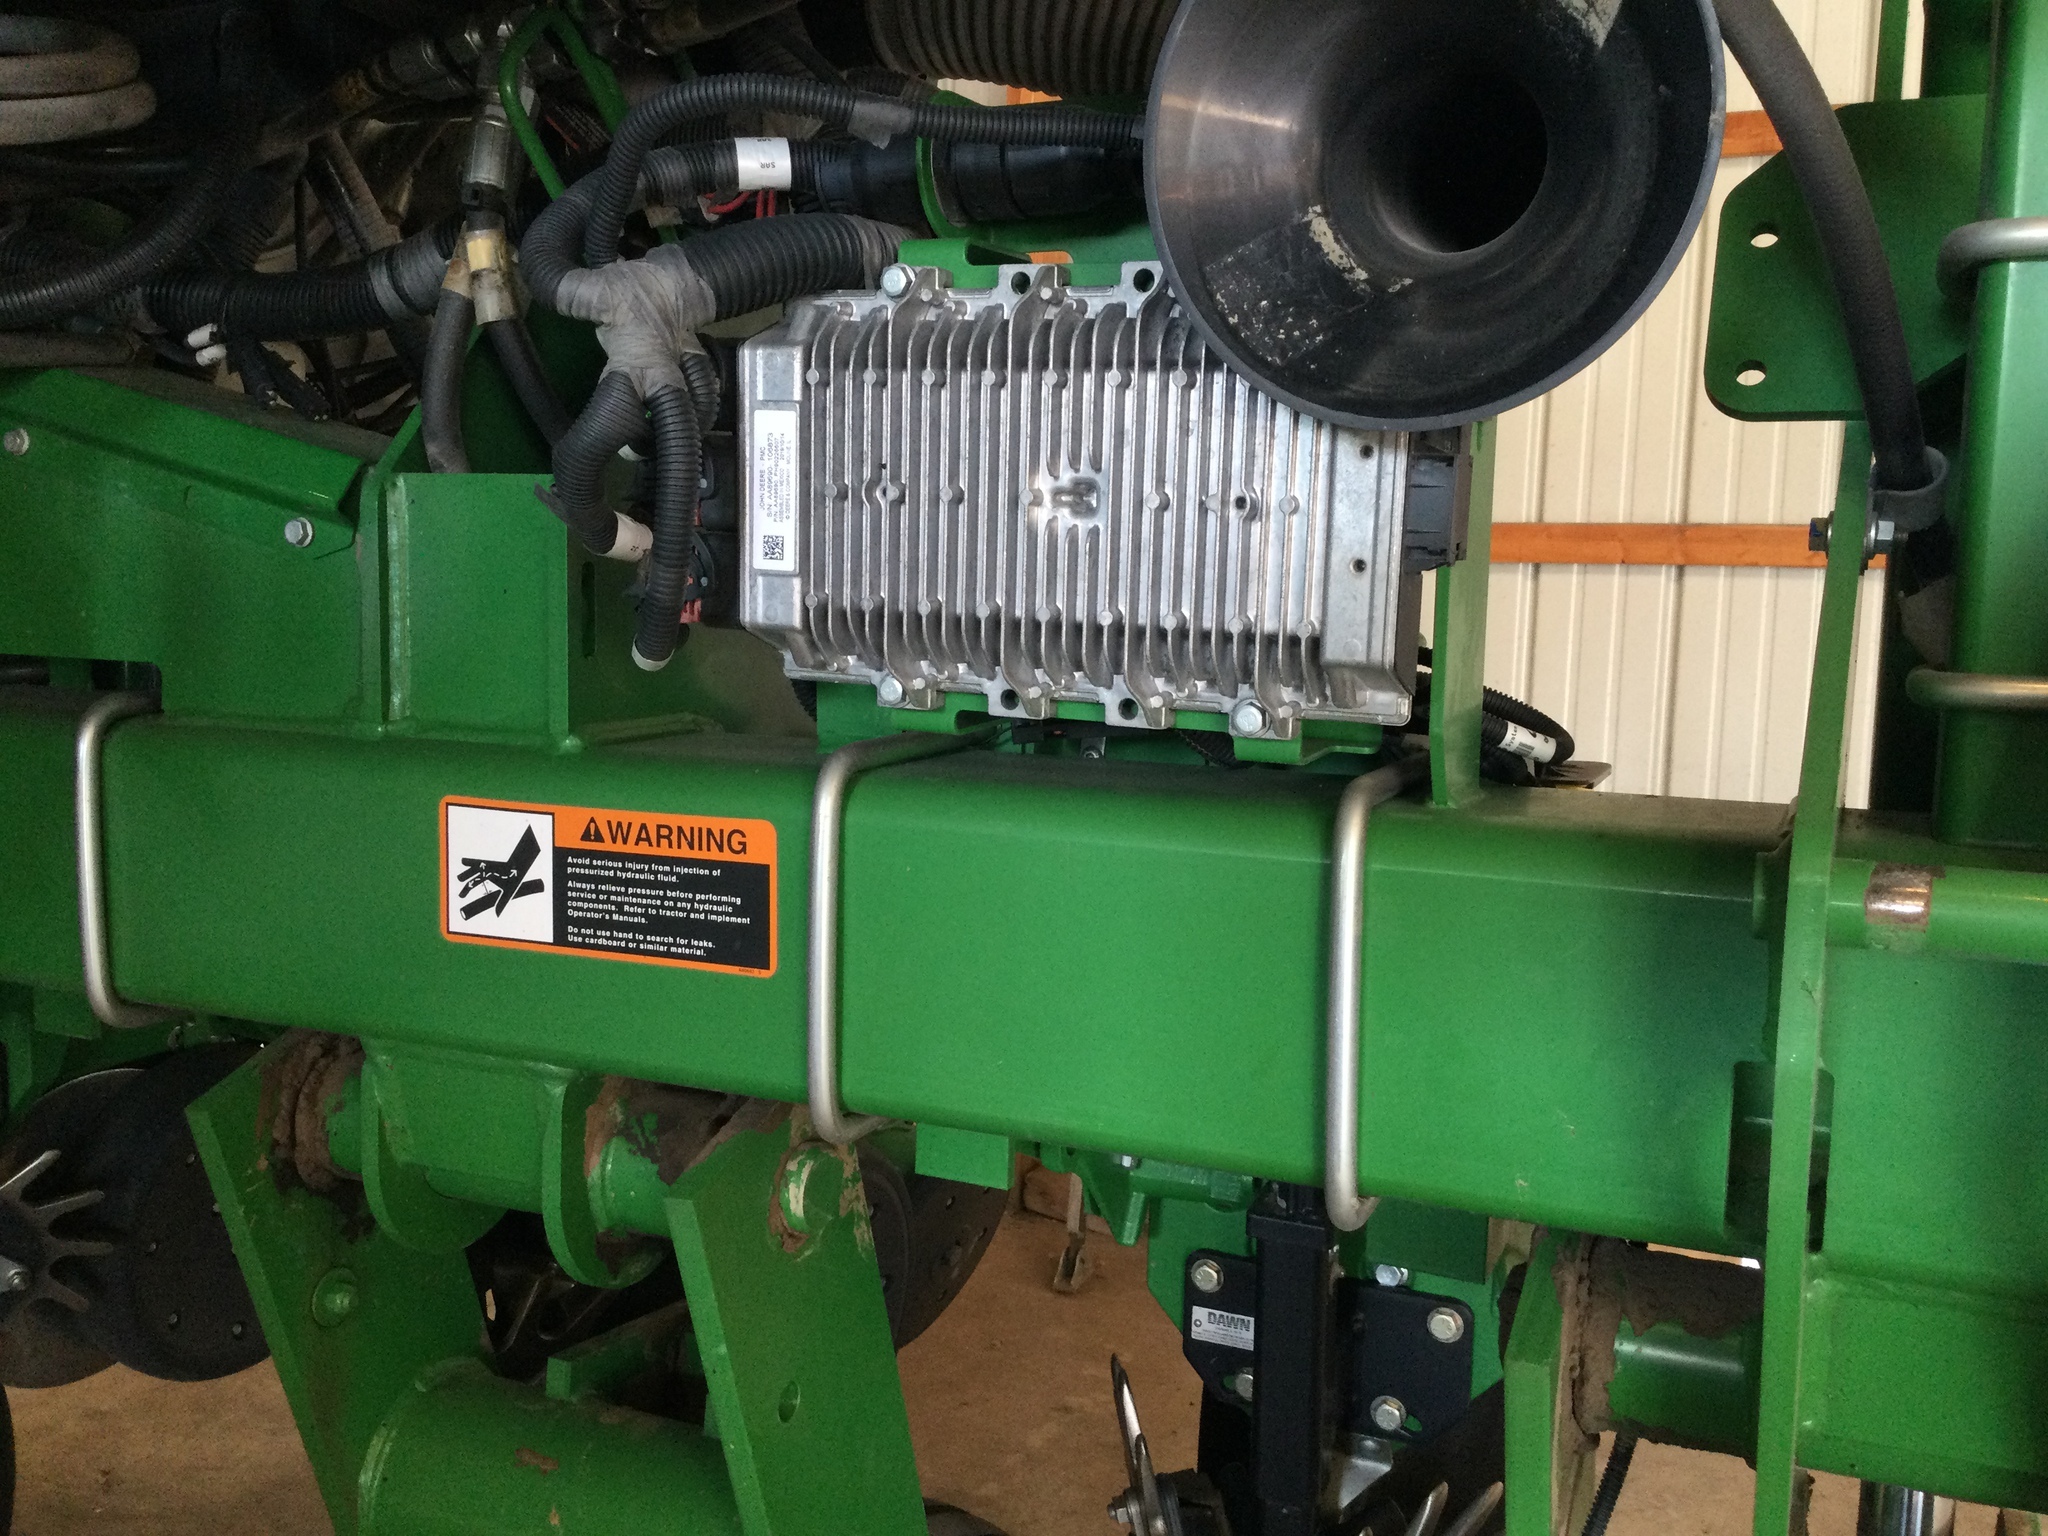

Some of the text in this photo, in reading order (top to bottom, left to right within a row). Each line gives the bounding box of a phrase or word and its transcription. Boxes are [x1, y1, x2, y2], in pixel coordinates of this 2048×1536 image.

[606, 820, 747, 855] WARNING
[567, 856, 590, 865] Avoid
[592, 859, 622, 868] serious
[625, 861, 649, 871] injury
[651, 863, 671, 872] from
[673, 865, 709, 875] injection
[567, 867, 680, 882] pressurized hydraulic fluid.
[567, 880, 741, 905] Always relieve pressure before performing
[567, 891, 597, 900] service
[610, 894, 662, 906] maintenance
[676, 901, 691, 910] any
[694, 902, 733, 913] hydraulic
[567, 900, 619, 911] components.
[624, 905, 646, 914] Refer
[659, 909, 687, 918] tractor
[690, 912, 705, 920] and
[707, 913, 751, 925] implement
[567, 909, 649, 924] Operator's Manuals.
[567, 925, 579, 934] Do
[613, 931, 633, 940] hand
[635, 933, 644, 941] to
[646, 935, 674, 944] search
[676, 936, 689, 945] for
[691, 938, 716, 949] leaks.
[567, 934, 583, 943] Use
[585, 937, 626, 947] cardboard
[639, 942, 668, 952] similar
[670, 946, 707, 957] material.
[1207, 1311, 1251, 1332] DAWN
